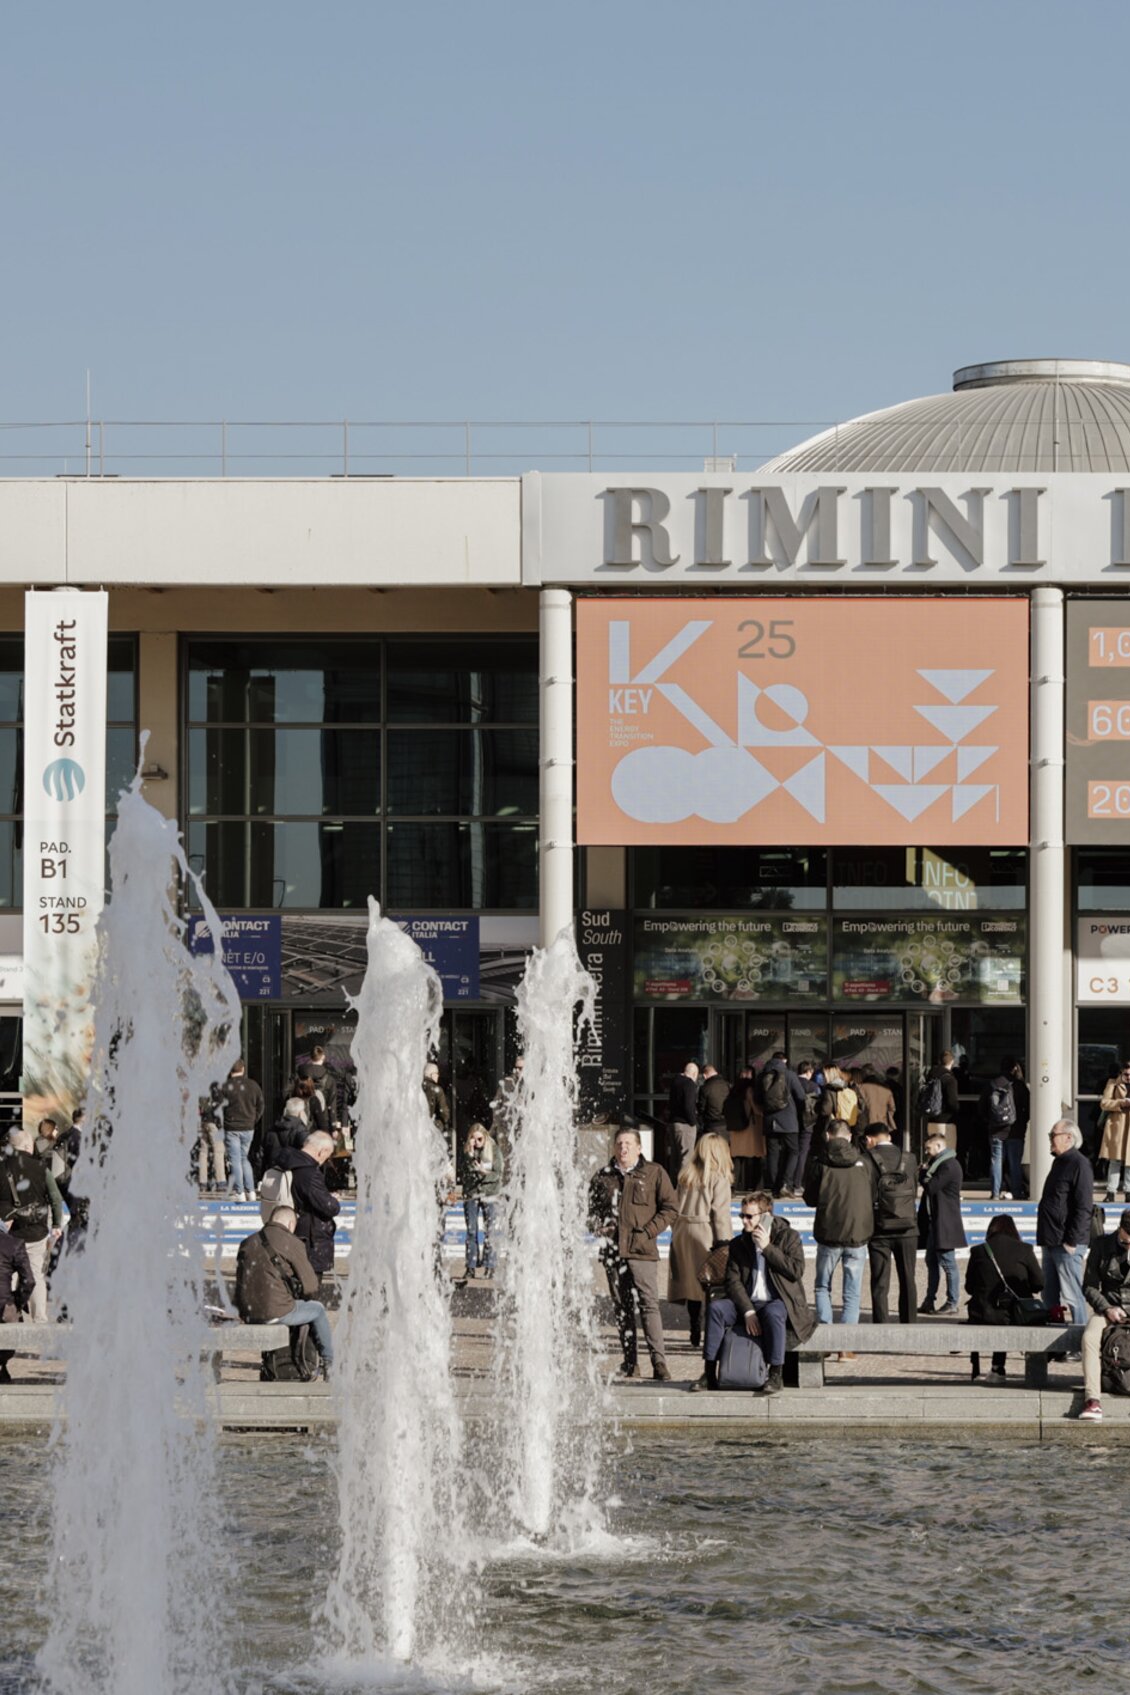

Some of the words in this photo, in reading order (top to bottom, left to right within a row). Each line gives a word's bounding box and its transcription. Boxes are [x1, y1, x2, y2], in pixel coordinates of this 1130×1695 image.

[597, 486, 1048, 571] RIMINI
[737, 620, 796, 659] 25
[54, 619, 77, 748] Statkraft
[608, 688, 653, 714] KEY
[40, 842, 72, 853] PAD.
[41, 859, 68, 879] B1
[39, 897, 87, 908] STAND
[39, 914, 80, 934] 135
[582, 911, 610, 926] Sud
[222, 921, 270, 931] ONTACT
[412, 921, 468, 931] CONTACT
[643, 920, 716, 934] Empowering
[717, 921, 737, 932] the
[738, 920, 772, 932] future
[842, 921, 915, 934] Empowering
[916, 921, 935, 932] the
[937, 921, 970, 932] future
[582, 929, 622, 945] South
[1089, 977, 1119, 994] C3
[309, 1026, 325, 1034] PAD
[341, 1026, 358, 1034] STA
[790, 1028, 811, 1036] TAND
[850, 1028, 866, 1036] PAD
[883, 1028, 902, 1036] STAN
